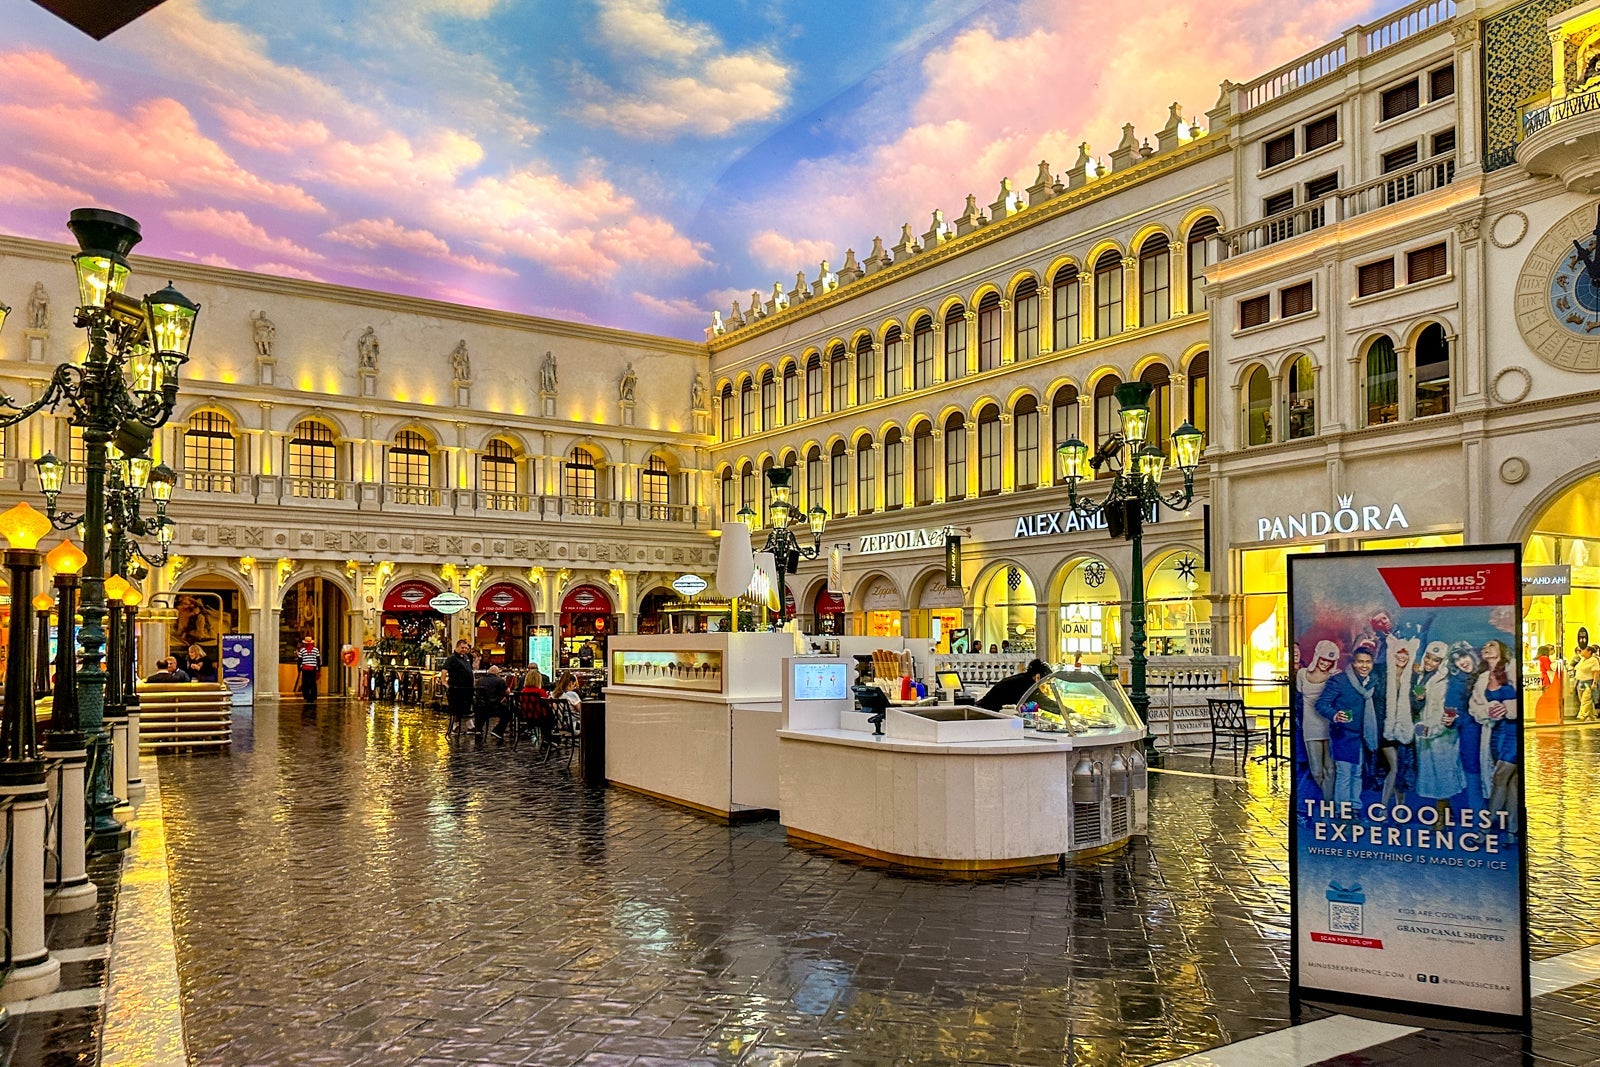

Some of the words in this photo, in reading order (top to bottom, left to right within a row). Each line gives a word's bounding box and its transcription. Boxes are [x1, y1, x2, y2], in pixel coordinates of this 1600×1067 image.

[1014, 511, 1062, 538] ALEX
[1065, 507, 1109, 532] AND
[1257, 503, 1409, 541] PANDORA
[859, 530, 926, 553] ZEPPOLA
[1532, 576, 1550, 585] AND
[1551, 576, 1567, 584] ANI
[1061, 624, 1072, 634] ND
[1074, 624, 1088, 634] ANI
[1189, 637, 1212, 645] THIN
[1148, 708, 1174, 720] GRAN
[1175, 708, 1198, 718] CANAL
[1304, 799, 1353, 820] THE
[1367, 802, 1509, 830] COOLEST
[1315, 822, 1499, 854] EXPERIENCE
[1308, 846, 1343, 857] WHERE
[1347, 849, 1413, 863] EVERYTHING
[1416, 855, 1426, 863] IS
[1429, 856, 1464, 867] MADE
[1467, 859, 1483, 868] OF
[1487, 860, 1508, 870] ICE
[1396, 924, 1430, 934] GRAND
[1431, 928, 1462, 938] CANAL
[1464, 931, 1506, 942] SHOPPES
